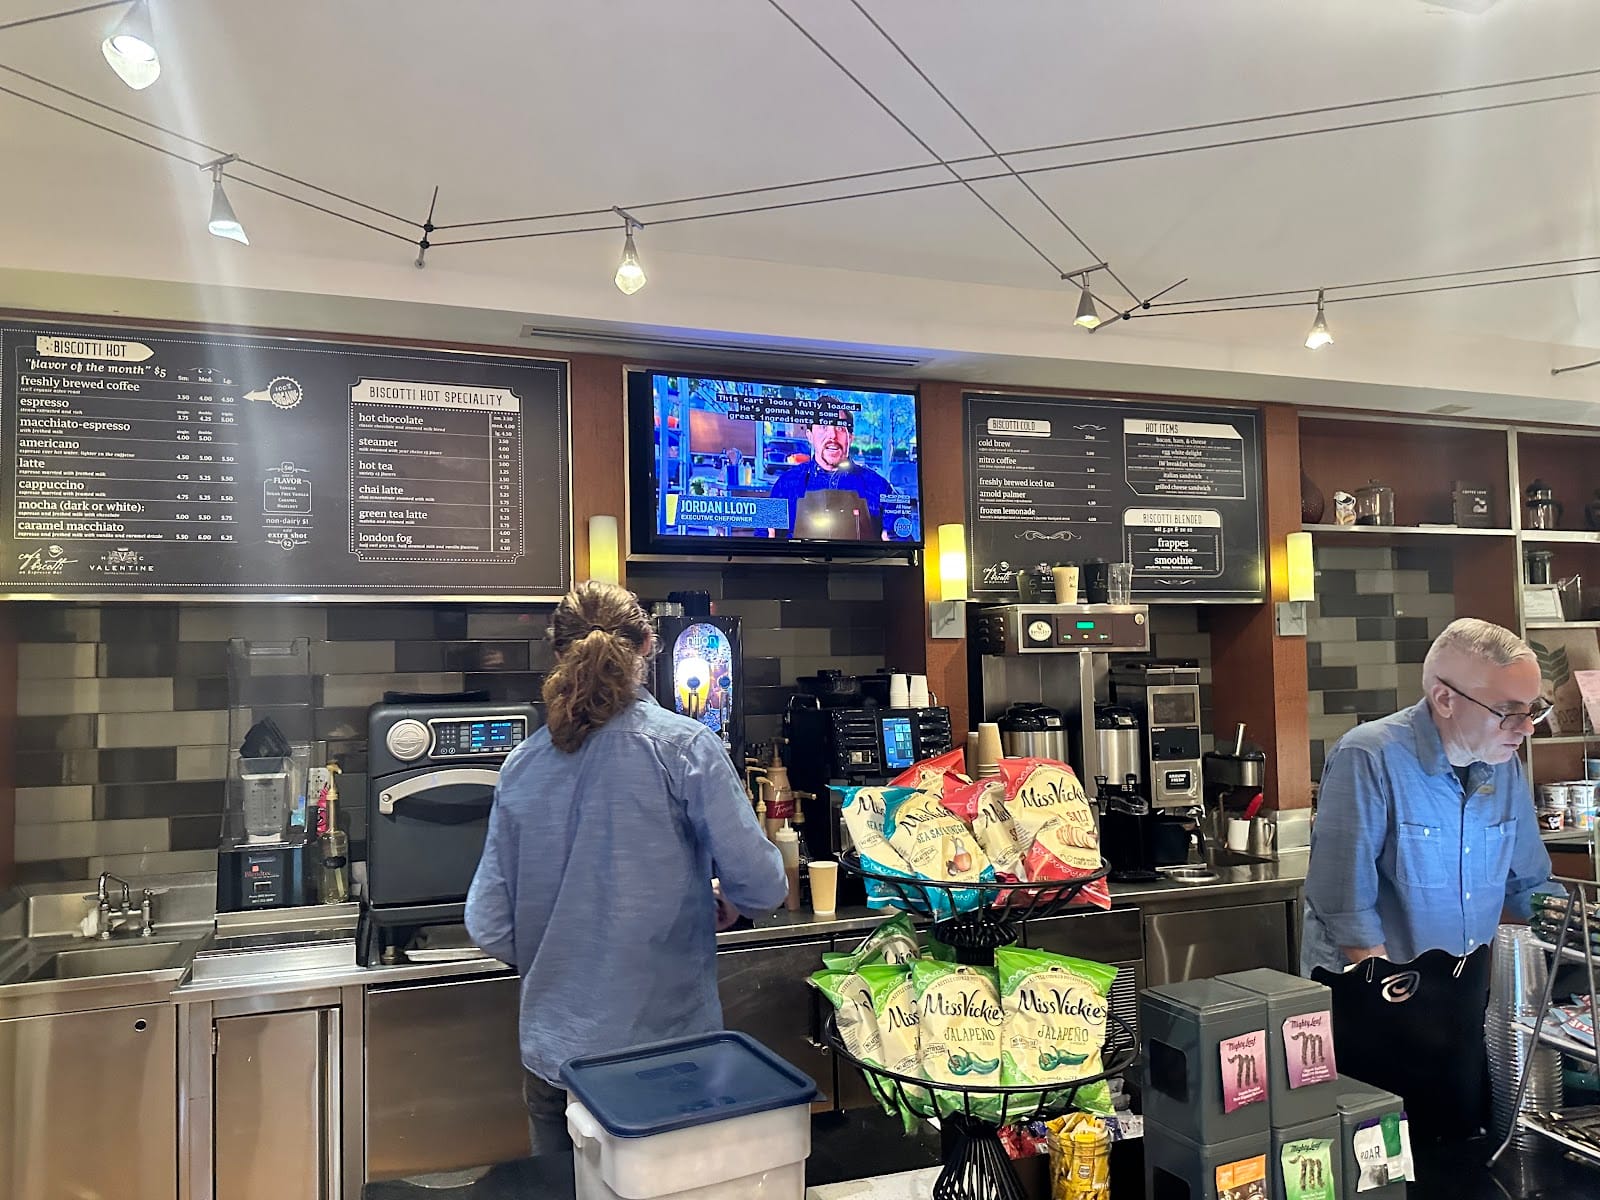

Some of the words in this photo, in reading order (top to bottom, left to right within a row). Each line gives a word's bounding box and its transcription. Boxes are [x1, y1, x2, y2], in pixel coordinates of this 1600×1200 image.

[54, 341, 101, 355] BISCOTTI
[107, 344, 127, 357] HOT
[71, 362, 82, 373] of
[86, 363, 104, 372] the
[154, 366, 166, 378] $5
[21, 375, 60, 388] freshly
[63, 378, 104, 389] brewed
[106, 380, 140, 391] coffee
[370, 387, 416, 401] BISCOTTI
[420, 390, 440, 402] HOT
[444, 392, 502, 406] SPECIALITY
[20, 398, 69, 408] espresso
[744, 397, 763, 405] cart
[769, 399, 793, 407] looks
[799, 401, 822, 409] fully
[827, 403, 860, 411] loaded.
[740, 405, 760, 413] He's
[765, 407, 790, 415] gonna
[359, 413, 376, 422] hot
[378, 414, 424, 425] chocolate
[760, 415, 814, 424] ingredients
[819, 418, 833, 426] for
[20, 418, 131, 432] macchiato-espresso
[993, 420, 1019, 430] BISCOTTI
[1021, 421, 1036, 431] COLD
[1146, 423, 1157, 433] HOT
[1160, 424, 1179, 433] ITEMS
[20, 439, 79, 449] americano
[359, 438, 398, 447] steamer
[979, 439, 993, 447] cold
[19, 458, 45, 468] latte
[359, 461, 376, 470] hot
[378, 462, 393, 471] tea
[979, 456, 995, 464] nitro
[997, 457, 1017, 465] coffee
[19, 480, 85, 490] cappuccino
[274, 477, 302, 485] FLAVOR
[980, 478, 1003, 488] freshly
[1004, 479, 1028, 487] brewed
[1029, 479, 1043, 487] iced
[1044, 480, 1055, 488] tea
[359, 485, 380, 494] chai
[381, 485, 404, 495] latte
[1003, 491, 1026, 499] palmer
[18, 500, 57, 511] mocha
[60, 500, 89, 512] (dark
[106, 502, 145, 513] white):
[681, 500, 722, 513] JORDAN
[725, 502, 757, 515] LLOYD
[980, 507, 1001, 515] frozen
[1003, 507, 1036, 515] lemonade
[359, 510, 387, 520] green
[389, 511, 404, 519] tea
[406, 510, 427, 519] latte
[1143, 514, 1172, 524] BISCOTTI
[1175, 515, 1202, 524] BLENDED
[18, 520, 64, 531] caramel
[66, 521, 124, 532] macchiato
[359, 533, 394, 542] london
[396, 533, 412, 544] fog
[1158, 538, 1189, 550] frappes
[1155, 556, 1193, 565] smoothie
[1021, 787, 1055, 808] Miss
[1067, 810, 1089, 822] SALT
[924, 993, 962, 1017] Miss
[1018, 989, 1056, 1014] Miss
[944, 1027, 995, 1041] JALAPEÑO
[1038, 1025, 1089, 1042] JALAPEÑO
[1361, 1146, 1381, 1160] ROAR
